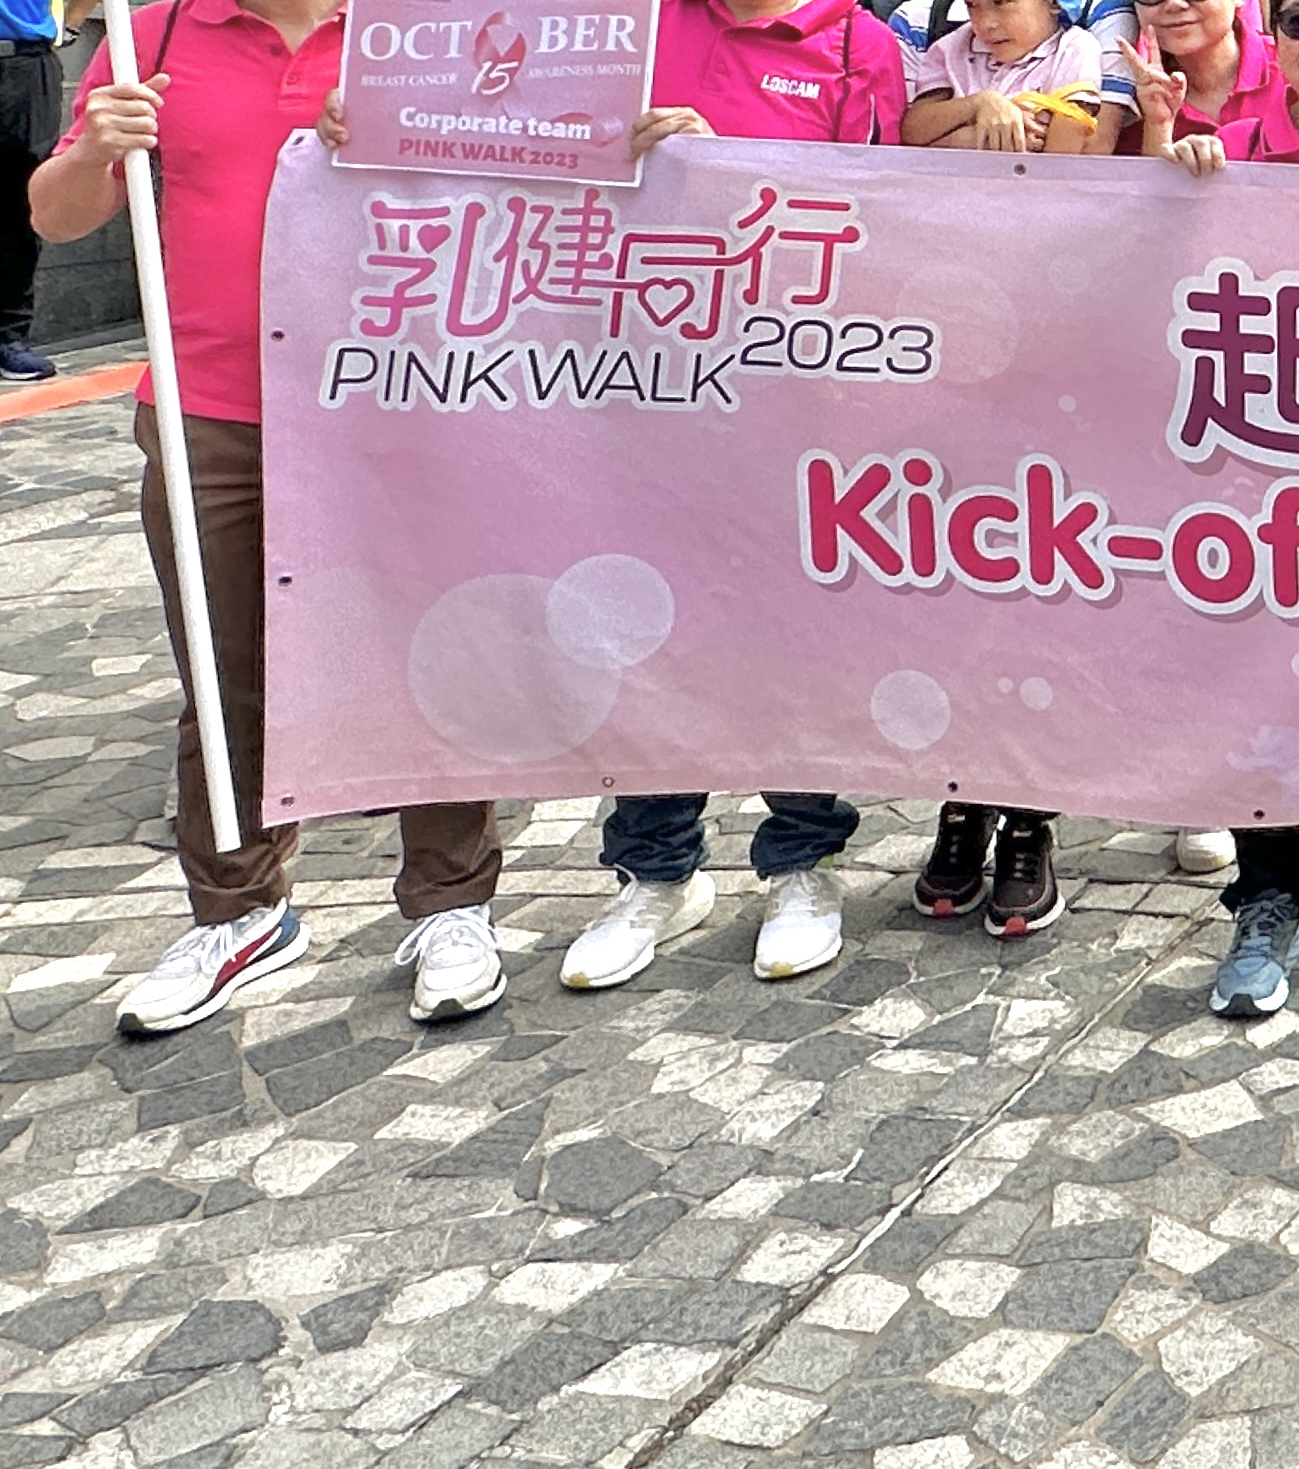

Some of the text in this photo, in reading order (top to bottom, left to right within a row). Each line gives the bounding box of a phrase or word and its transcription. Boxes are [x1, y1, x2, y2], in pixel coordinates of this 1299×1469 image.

[361, 72, 459, 87] BREAST CANCER
[471, 60, 520, 96] 15
[596, 62, 642, 78] MONTH
[760, 74, 822, 100] LOSCAM
[400, 106, 592, 141] Corporate team
[399, 137, 580, 171] PINK WALK 2023
[358, 187, 862, 341] 乳健同行
[328, 316, 936, 405] PINK WALK 2023
